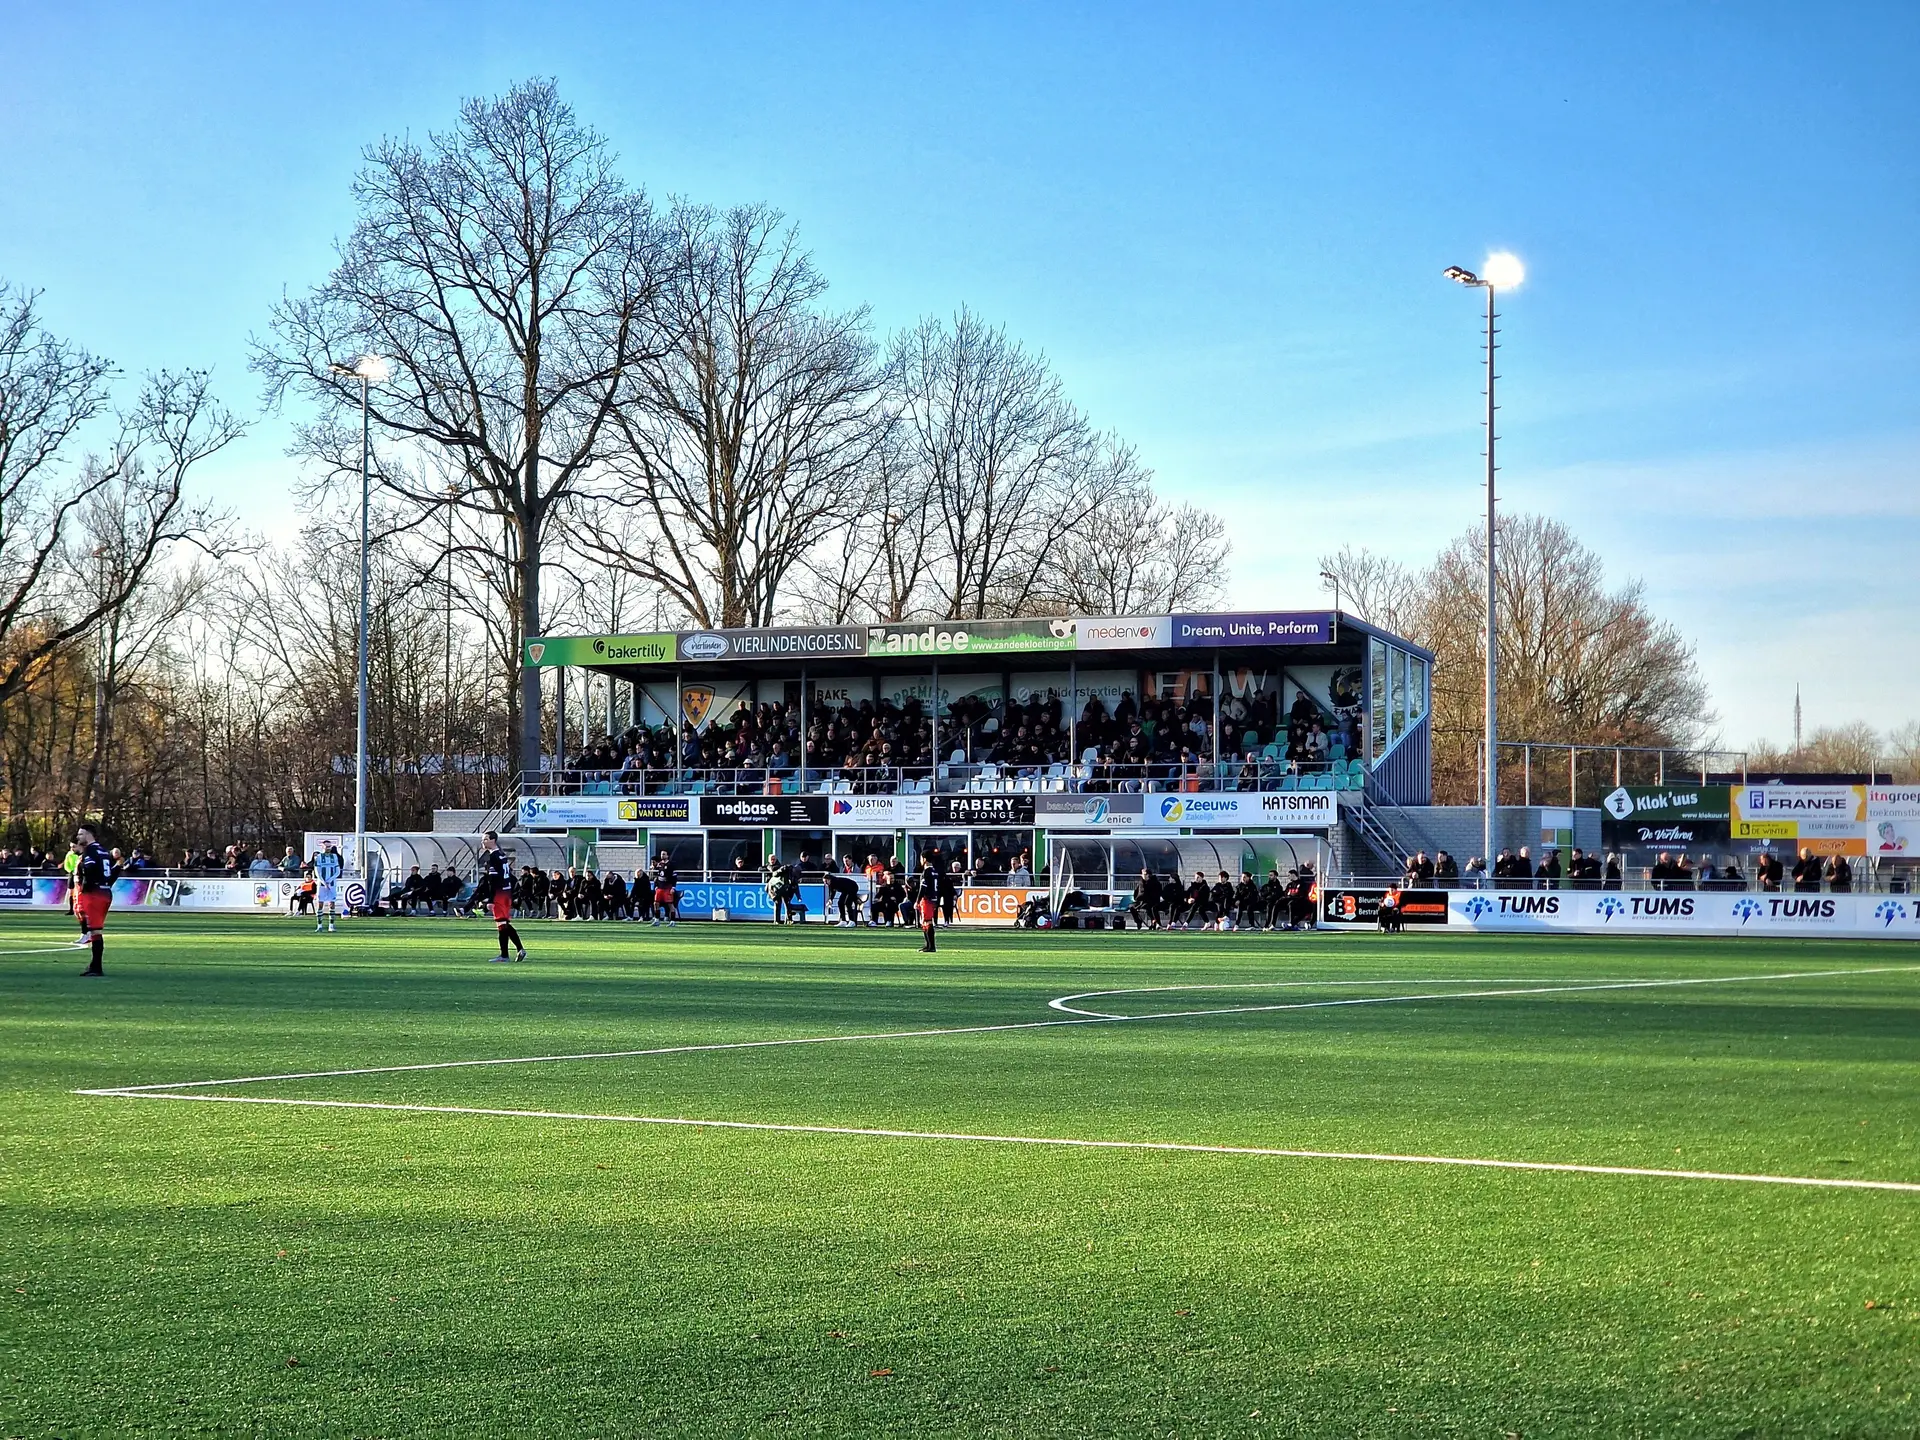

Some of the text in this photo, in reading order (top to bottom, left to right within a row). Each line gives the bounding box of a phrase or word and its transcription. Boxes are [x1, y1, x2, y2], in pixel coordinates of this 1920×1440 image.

[1182, 621, 1319, 638] Dream, Unite, Perform
[732, 633, 862, 653] VIERLINDENGOES.NL
[868, 626, 969, 653] Zandee
[971, 638, 1076, 650] www.zandeekloetinge.nl
[607, 643, 666, 660] bakertilly
[855, 799, 893, 808] JUSTION
[950, 798, 1014, 811] FABERY
[1185, 799, 1238, 811] Zeeuws
[1262, 795, 1329, 810] KATSMAN
[1768, 798, 1847, 809] FRANSE
[638, 809, 687, 818] VAN DE LINDE
[855, 808, 893, 816] ADVOCATEN
[950, 811, 1015, 819] DE JONGE
[1266, 813, 1326, 821] houthandel
[1637, 827, 1653, 841] De
[102, 858, 112, 877] 5
[680, 886, 775, 909] eststrate
[1498, 896, 1560, 914] TUMS
[1630, 897, 1695, 915] TUMS
[1768, 899, 1836, 918] TUMS
